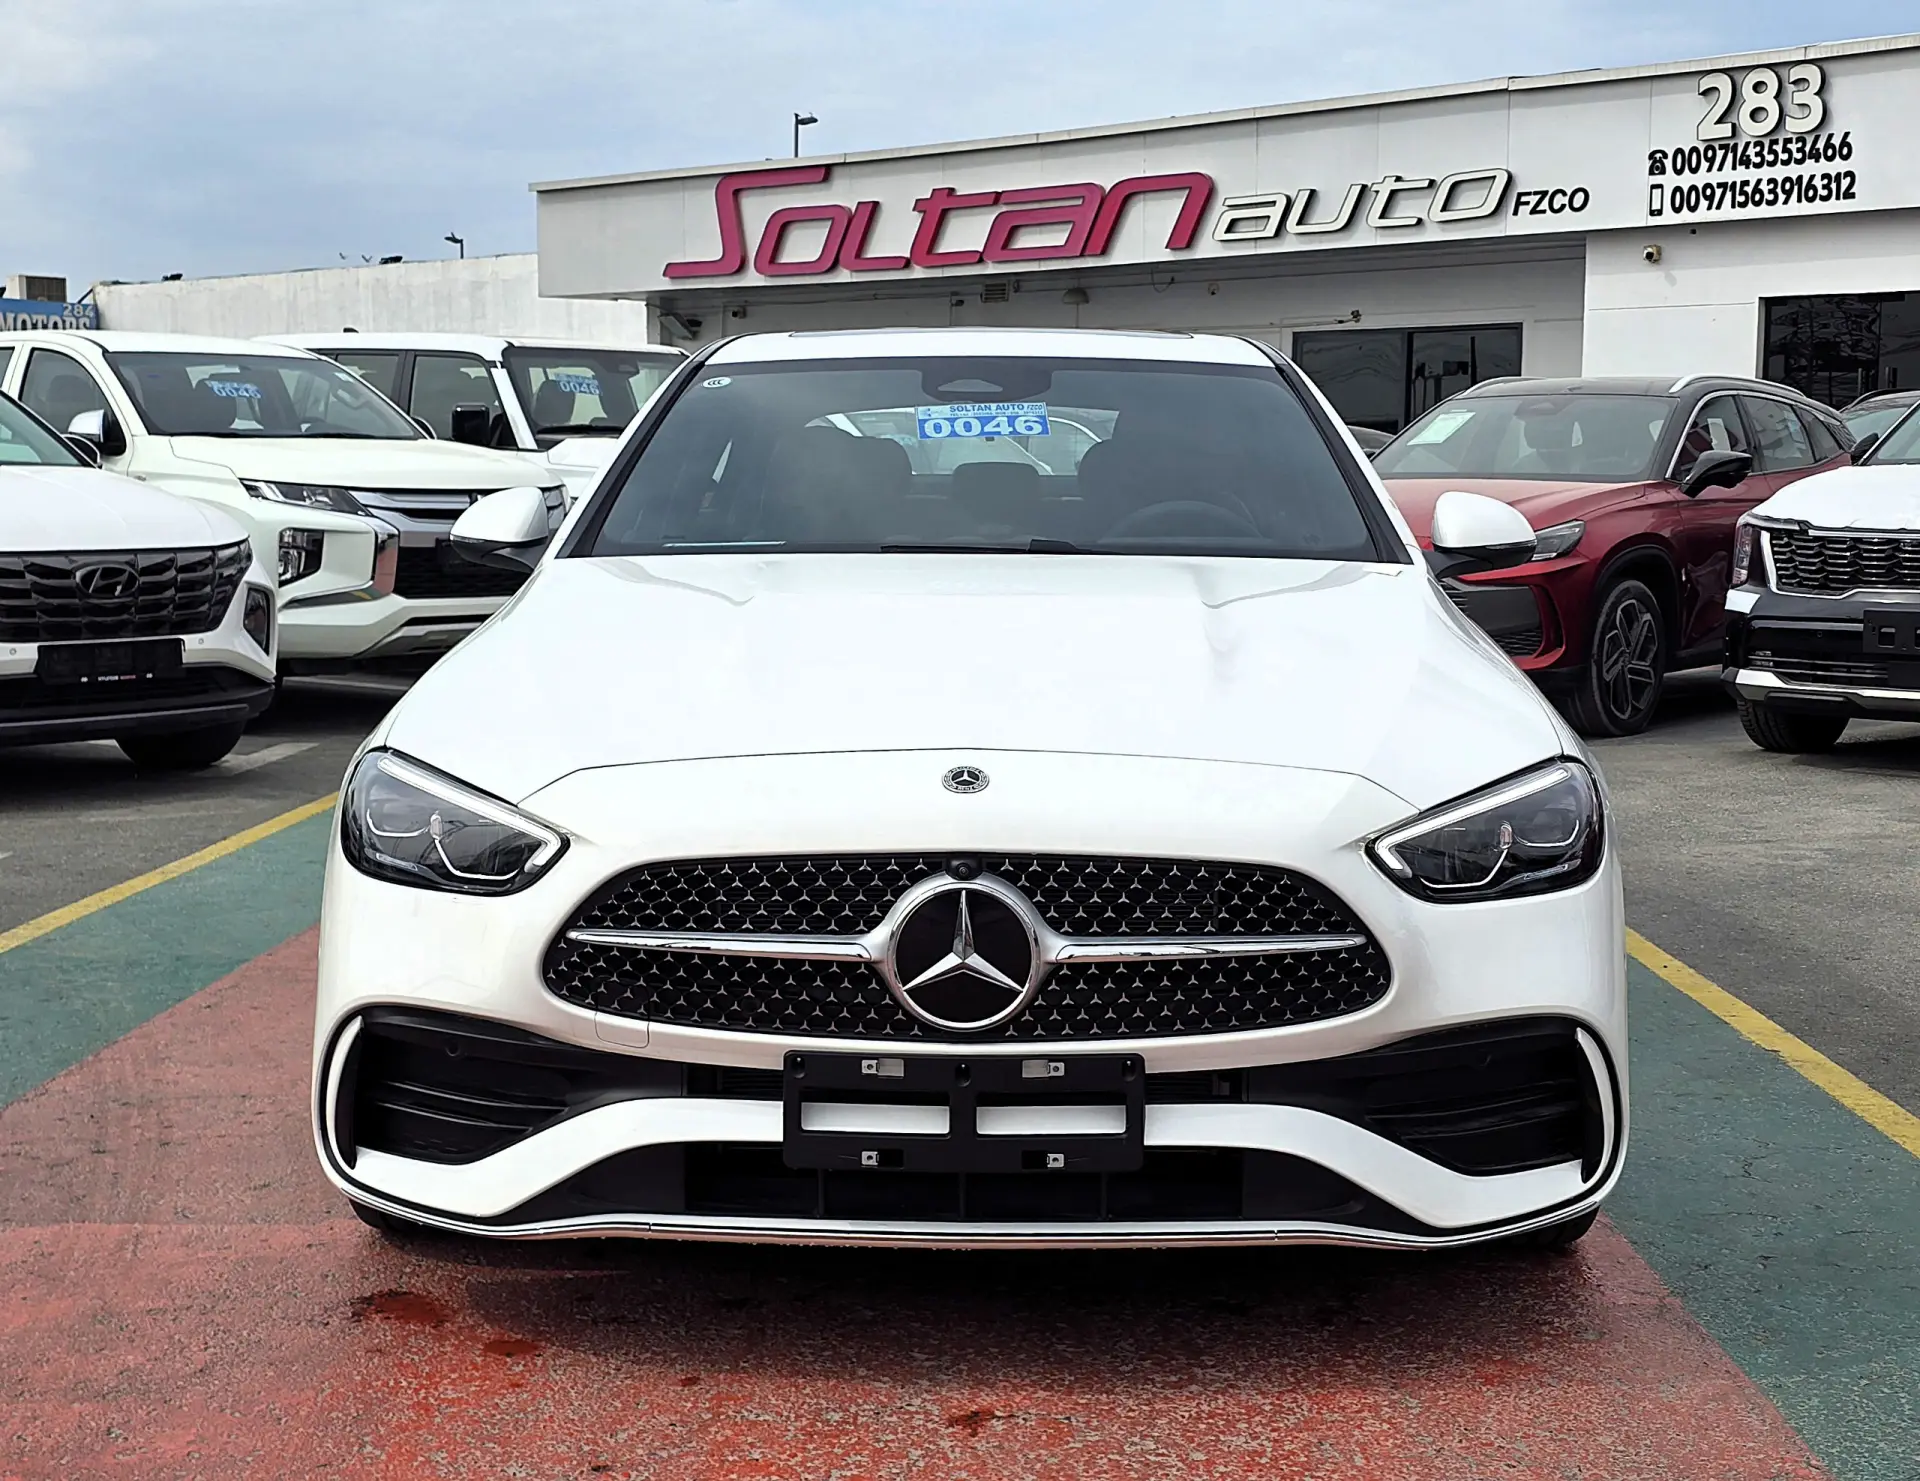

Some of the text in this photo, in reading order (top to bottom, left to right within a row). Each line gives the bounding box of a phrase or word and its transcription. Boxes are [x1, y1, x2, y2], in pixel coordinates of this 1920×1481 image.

[1697, 62, 1828, 141] 283
[1671, 131, 1853, 176] 0097143553466
[1512, 187, 1590, 216] FZCO
[1670, 170, 1856, 214] 00971563916312
[62, 303, 95, 318] 284
[949, 403, 992, 413] SOLTAN
[995, 403, 1025, 411] AUTO
[924, 416, 1043, 438] 0046
